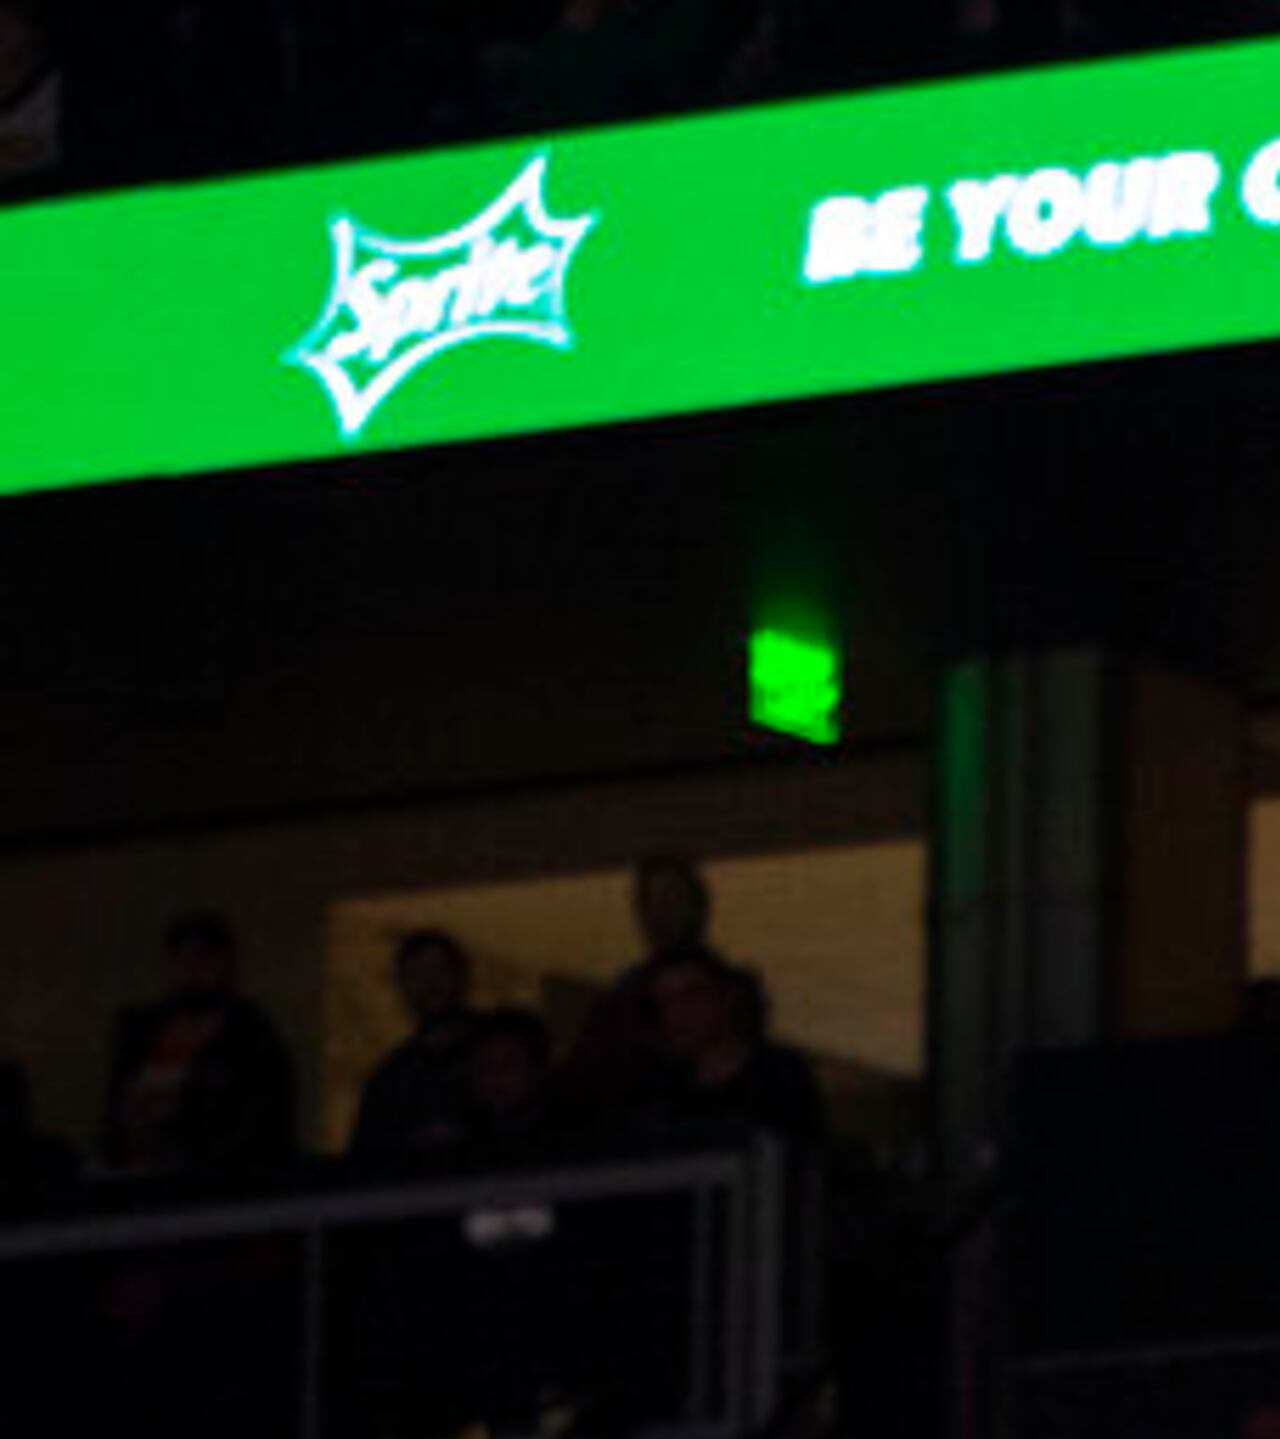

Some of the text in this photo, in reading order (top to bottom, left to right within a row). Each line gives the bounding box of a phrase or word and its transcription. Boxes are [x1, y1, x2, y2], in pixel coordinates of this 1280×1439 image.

[803, 185, 929, 283] BE
[947, 150, 1221, 261] YOUR
[324, 236, 556, 361] Sprite
